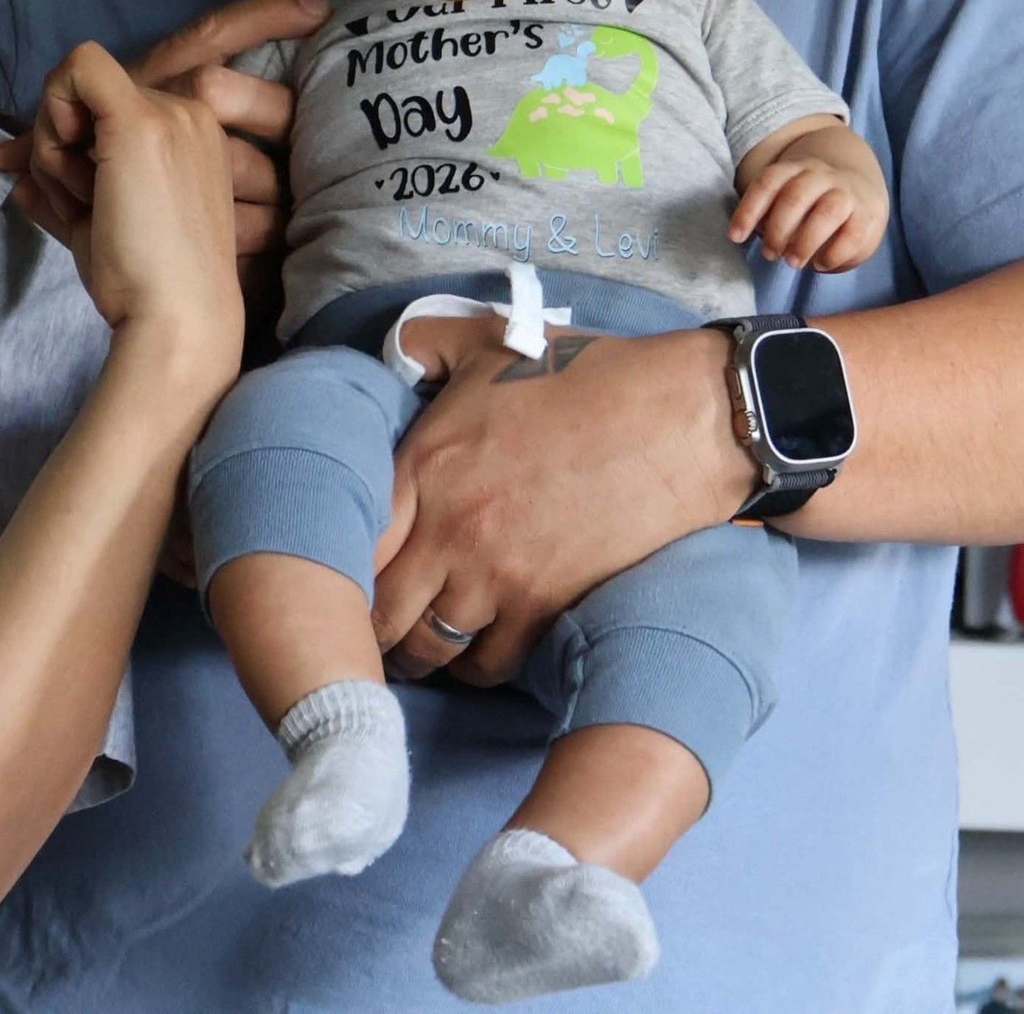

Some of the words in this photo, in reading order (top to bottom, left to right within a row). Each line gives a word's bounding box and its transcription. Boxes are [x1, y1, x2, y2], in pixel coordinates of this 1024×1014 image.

[346, 18, 544, 88] Mother's
[359, 86, 473, 151] Day
[389, 161, 486, 202] 2026
[396, 205, 533, 263] Mommy
[547, 213, 579, 256] &
[594, 213, 660, 261] Levi
